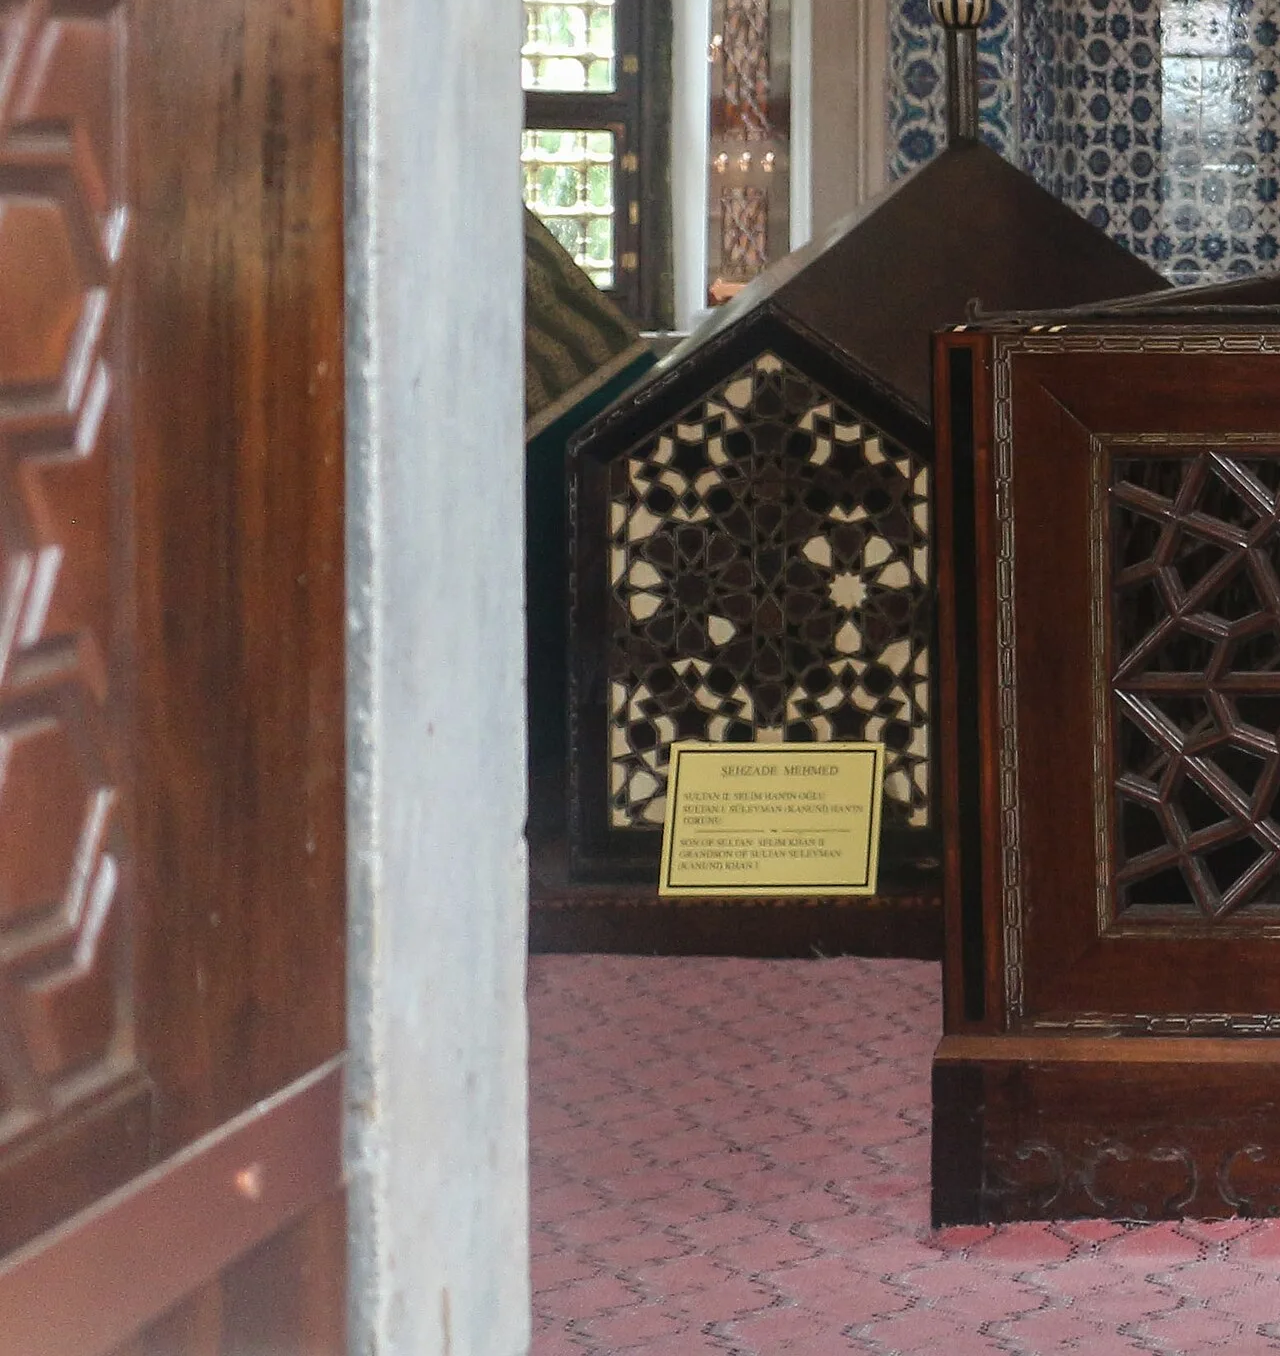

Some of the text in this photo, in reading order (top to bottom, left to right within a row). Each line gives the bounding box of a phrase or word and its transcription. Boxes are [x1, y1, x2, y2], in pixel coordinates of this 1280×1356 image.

[721, 763, 840, 778] ŞEHZADE MEHMED
[679, 850, 733, 859] GRANDSON
